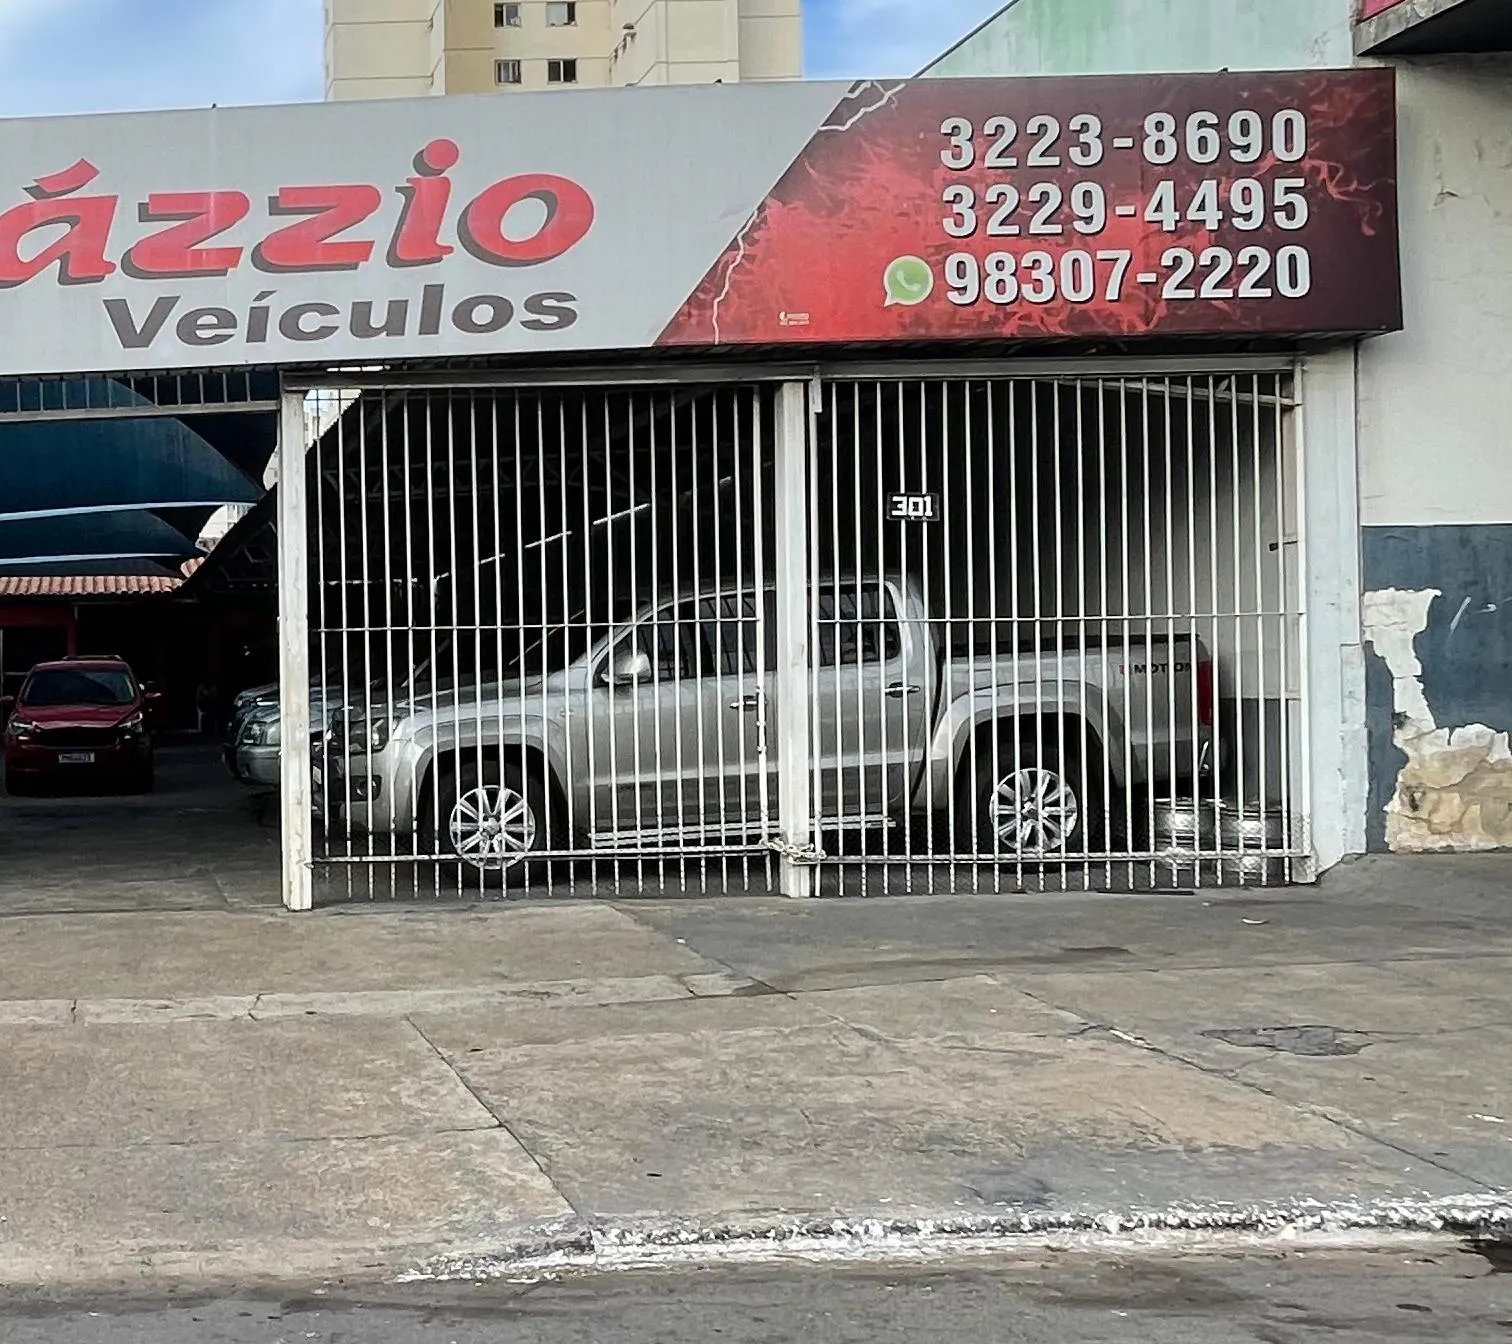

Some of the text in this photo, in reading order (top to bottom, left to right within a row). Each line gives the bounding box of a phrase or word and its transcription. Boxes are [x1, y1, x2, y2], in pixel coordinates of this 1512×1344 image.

[939, 108, 1308, 171] 3223-8690
[941, 177, 1309, 238] 3229-4495
[943, 244, 1311, 305] 98307-2220
[103, 283, 579, 349] Veículos
[891, 495, 933, 517] 301
